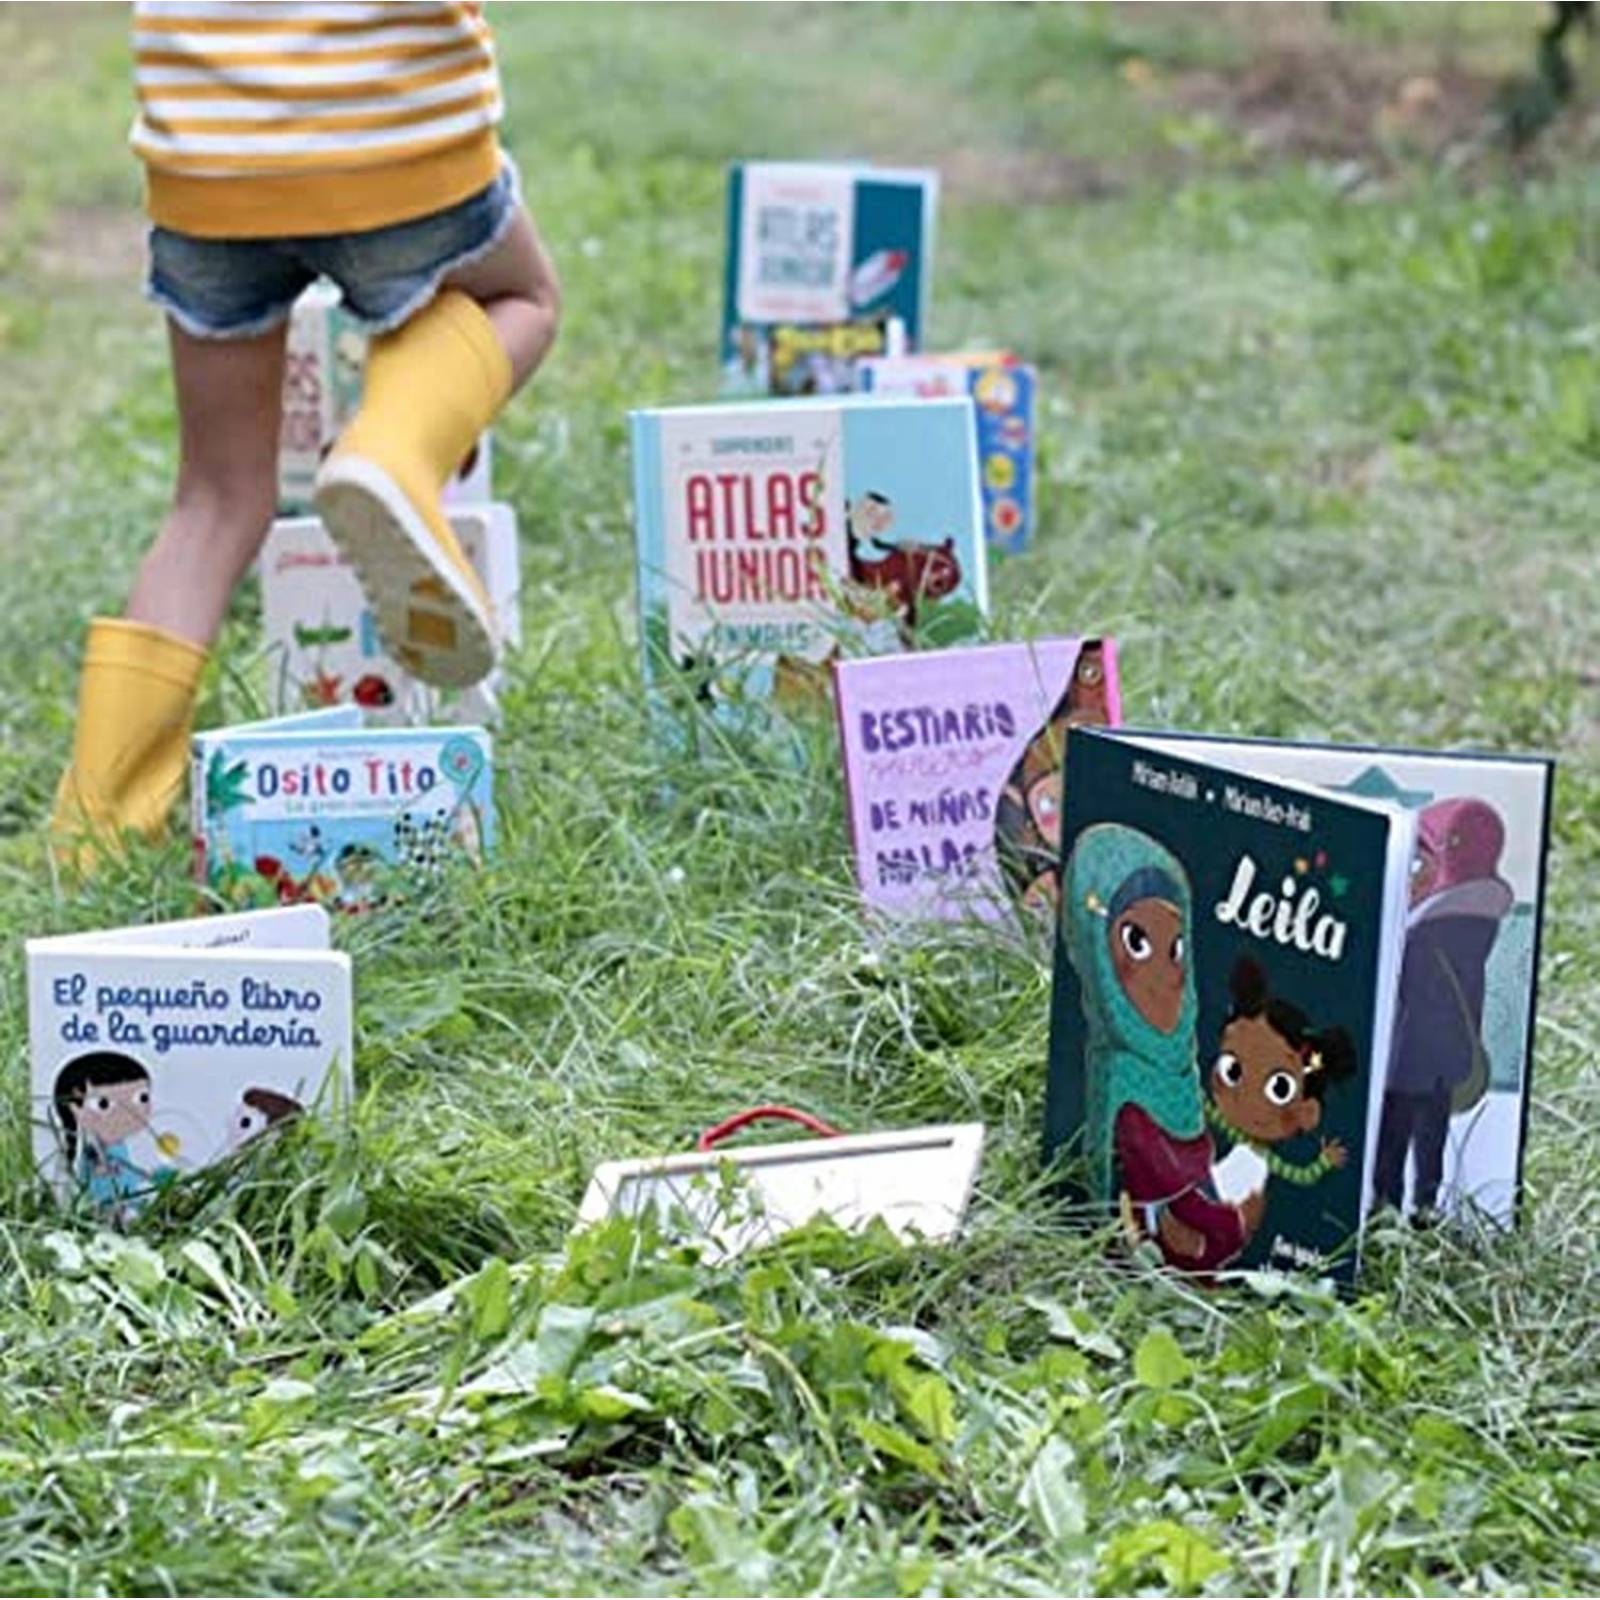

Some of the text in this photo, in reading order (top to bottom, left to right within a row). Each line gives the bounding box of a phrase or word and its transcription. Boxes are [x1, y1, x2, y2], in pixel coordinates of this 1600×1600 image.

[685, 472, 827, 541] ATLAS
[257, 759, 436, 798] Osito Tito
[870, 799, 901, 832] DE
[1214, 854, 1347, 961] Leila
[53, 972, 322, 1015] El pequeño libro
[60, 1011, 322, 1053] de la guardería
